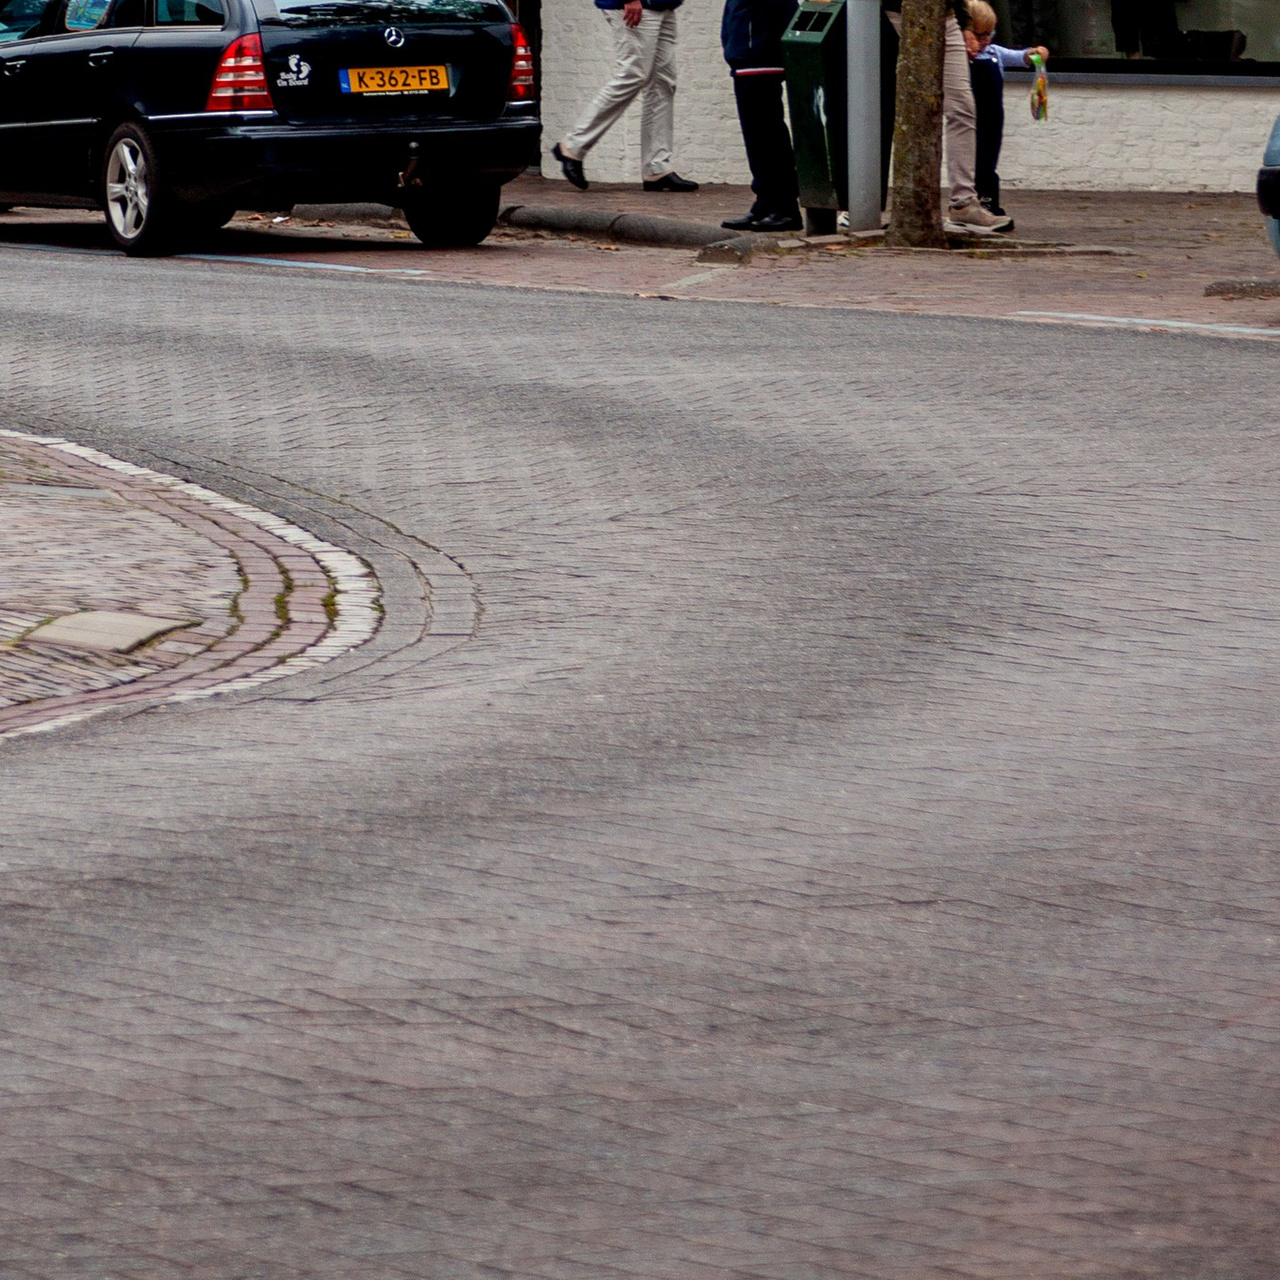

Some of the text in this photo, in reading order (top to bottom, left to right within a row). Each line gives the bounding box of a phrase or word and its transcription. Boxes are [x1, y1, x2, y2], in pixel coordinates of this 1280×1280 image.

[279, 72, 297, 80] Baby
[357, 68, 440, 88] K-362-FB
[276, 78, 309, 87] On Board
